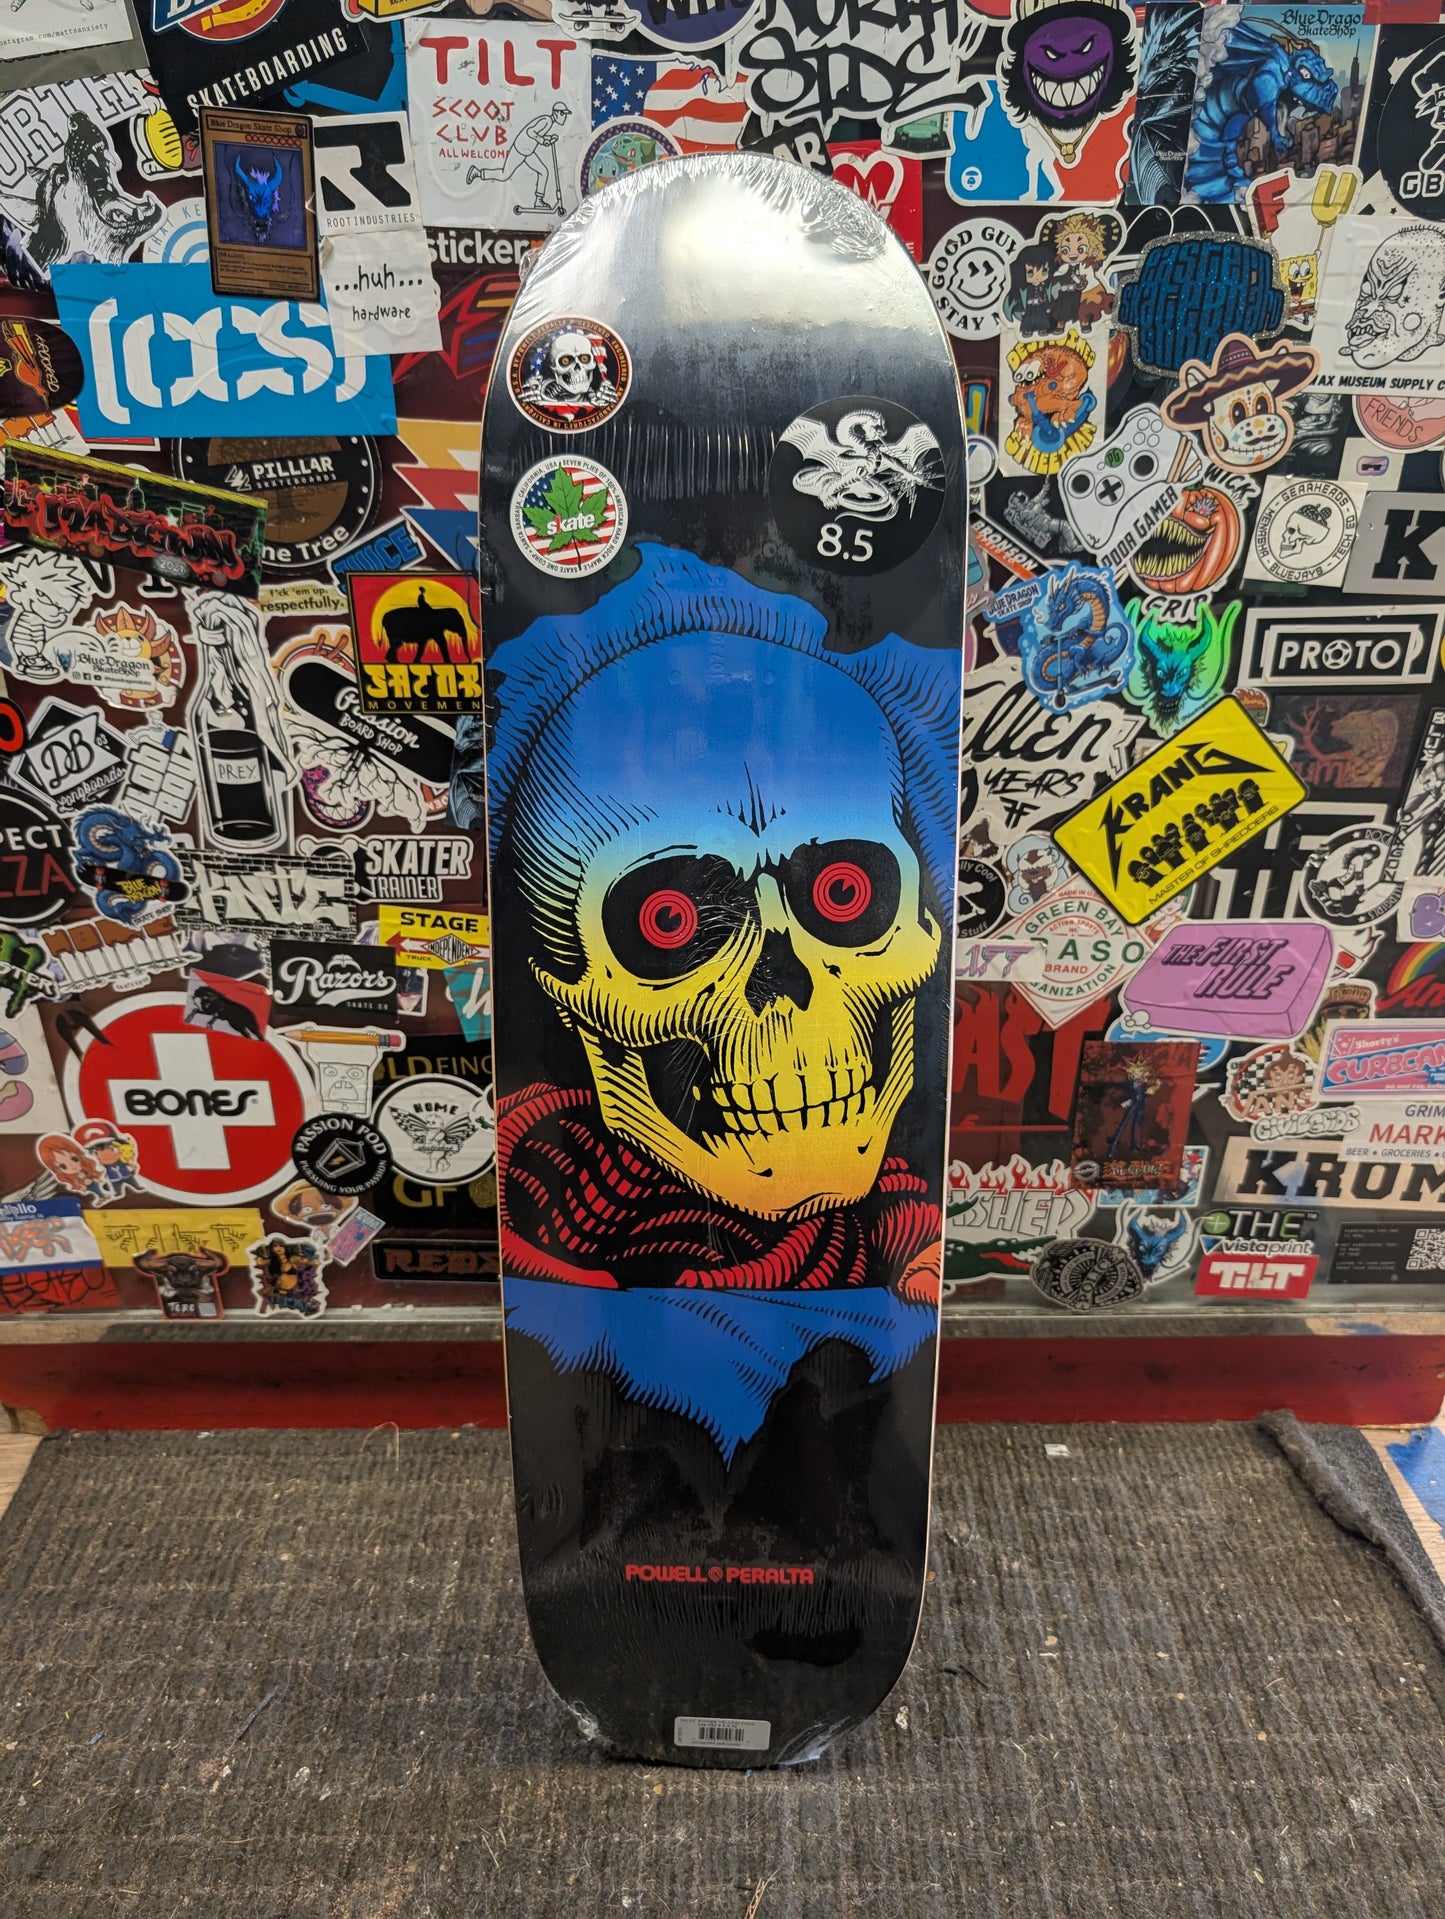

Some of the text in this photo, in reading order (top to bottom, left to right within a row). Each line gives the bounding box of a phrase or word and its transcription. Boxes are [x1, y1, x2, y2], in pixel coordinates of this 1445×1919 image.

[186, 26, 348, 118] SKATEBOARDING
[419, 36, 577, 89] TILT
[432, 98, 516, 122] SCOOT
[227, 120, 251, 130] Dragon
[274, 124, 292, 134] Shop
[438, 148, 459, 158] ALL
[1252, 171, 1358, 235] F U
[327, 212, 417, 229] ROOT INDUSTRIES
[932, 229, 973, 289] GOOD
[352, 305, 412, 322] hardware
[936, 296, 985, 331] STAY
[1339, 375, 1387, 388] MUSEUM
[1389, 377, 1433, 390] SUPPLY
[1363, 399, 1424, 443] FRIENDS
[545, 461, 558, 470] USA
[583, 462, 599, 473] PLIES
[599, 471, 607, 480] OF
[257, 474, 337, 490] SKATEBOARDS
[606, 478, 617, 494] 100%
[1281, 483, 1349, 508] GEARHEADS
[614, 494, 625, 528] AMERICAN
[1133, 484, 1179, 537] GAMER
[546, 512, 595, 536] skate
[1257, 508, 1276, 559] MENASHA
[296, 524, 351, 562] Tree
[518, 530, 530, 551] SANTA
[613, 528, 623, 546] HARD
[817, 522, 874, 563] 8.5
[971, 520, 1038, 573] BRONSON
[1332, 534, 1353, 561] TECH
[531, 552, 578, 574] SKATE ONE CORP
[602, 544, 616, 561] ROCK
[582, 557, 603, 572] MAPLE
[1269, 564, 1324, 581] BLUEJAYS
[260, 595, 345, 614] respectfully.
[1004, 584, 1040, 607] DRAGON
[1278, 639, 1401, 670] PROTO
[368, 700, 481, 711] MOVEMEN
[339, 714, 404, 757] BOARD SHOP
[218, 763, 257, 780] PREY
[983, 766, 1084, 799] YEARS
[0, 825, 62, 851] ECT
[366, 838, 469, 877] SKATER
[1148, 804, 1279, 905] MASTER OF SHREDDERS
[959, 860, 998, 882] lly Cool
[368, 877, 440, 900] TRAINER
[400, 911, 479, 934] STAGE
[960, 921, 988, 938] Stuff
[1024, 901, 1125, 936] GREEN BAY
[1049, 919, 1075, 932] ACTION
[406, 954, 433, 962] TRUCK
[1161, 937, 1289, 967] THE FIRST
[1044, 963, 1088, 974] BRAND
[273, 956, 397, 1006] Razors
[1193, 964, 1295, 1000] RULE
[124, 1088, 259, 1117] BONES
[412, 1102, 459, 1116] HOME
[294, 1117, 388, 1155] PASSION POD
[1346, 1147, 1431, 1159] BEER GROCERIES
[339, 1184, 366, 1195] YOUR
[365, 1159, 388, 1189] PASSION
[1229, 1210, 1305, 1240] THE
[1222, 1238, 1313, 1257] vistaprint
[1208, 1261, 1306, 1291] TILT
[625, 1564, 814, 1584] POWELL PERALTA
